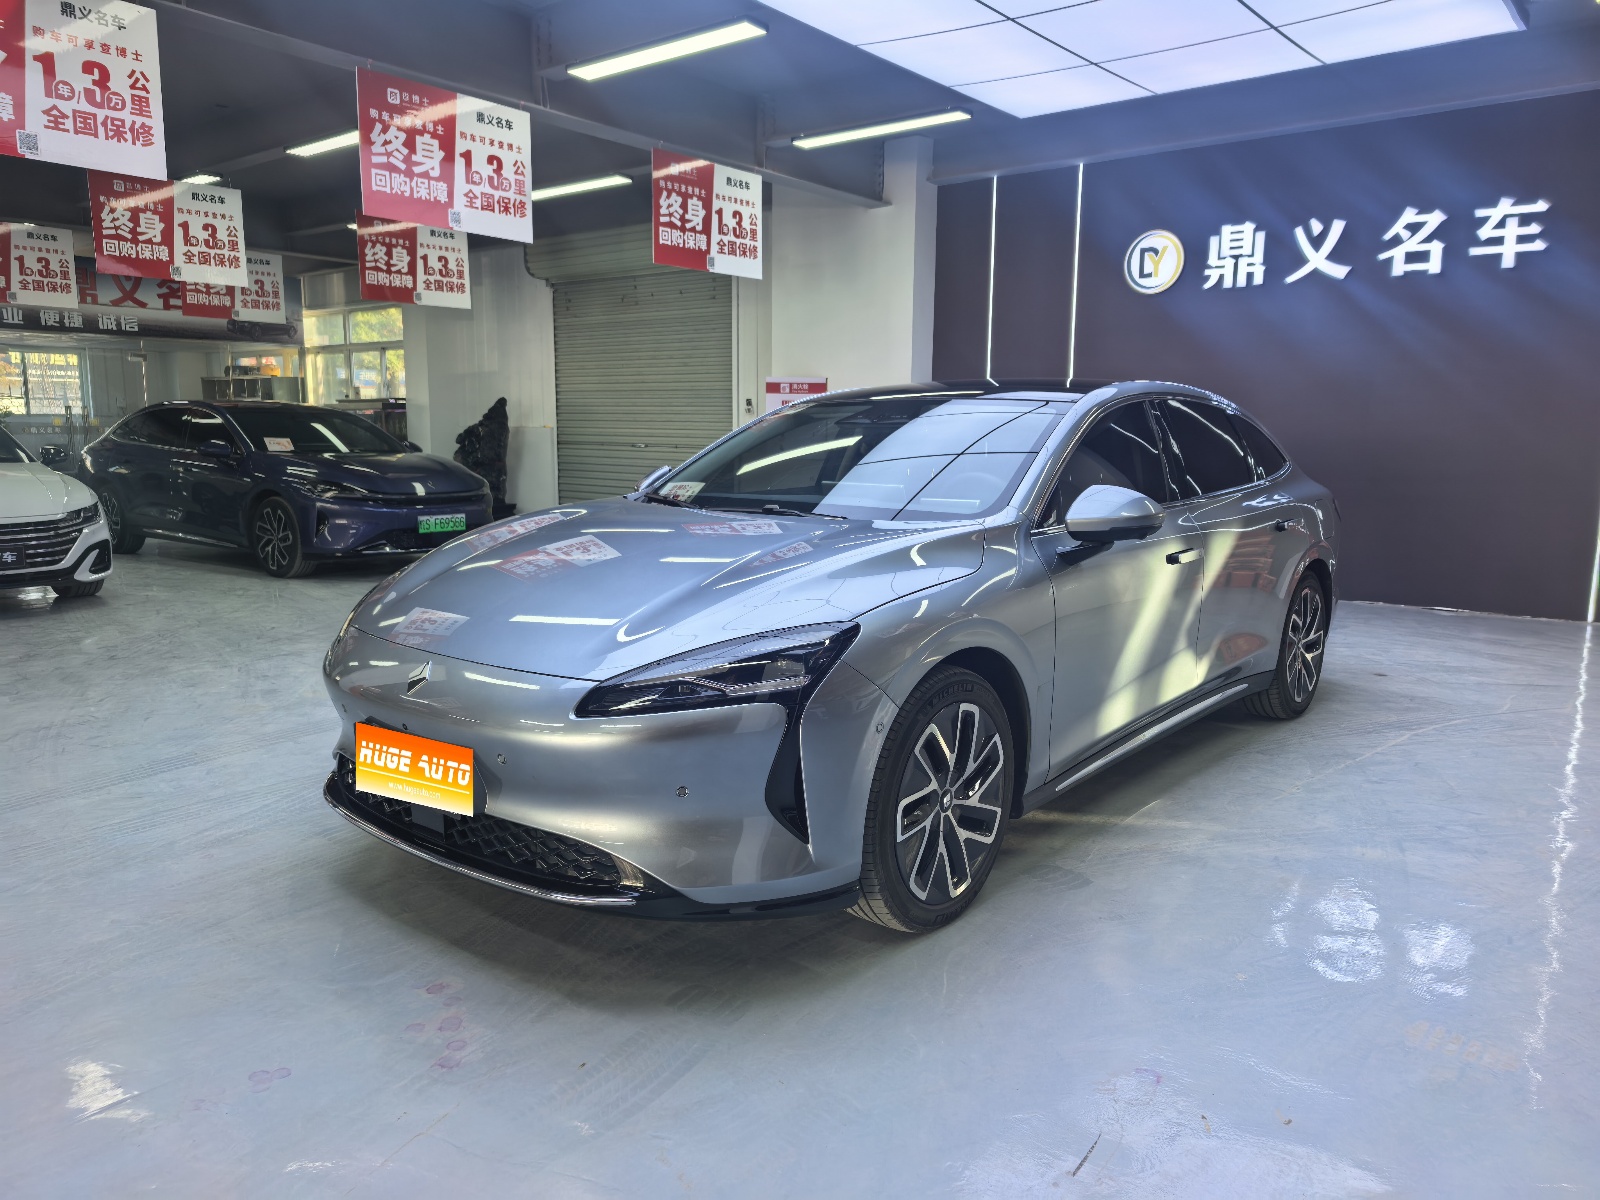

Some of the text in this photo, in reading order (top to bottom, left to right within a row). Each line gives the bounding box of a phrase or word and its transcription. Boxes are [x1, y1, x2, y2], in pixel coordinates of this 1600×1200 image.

[61, 1, 126, 30] 鼎义名车
[32, 25, 143, 62] 购车可享查博士
[41, 104, 155, 147] 全国保修
[369, 107, 445, 135] 购车可查博士
[476, 111, 514, 131] 鼎义名车
[370, 122, 445, 178] 终身
[371, 168, 449, 204] 回购保障
[726, 176, 751, 191] 鼎义名车
[463, 188, 528, 219] 全国保修
[659, 190, 706, 231] 终身
[100, 206, 165, 243] 终身
[103, 239, 170, 262] 回购保障
[659, 226, 707, 252] 回购保障
[716, 238, 758, 260] 全国保修
[1202, 196, 1551, 290] 鼎义名车
[182, 249, 242, 269] 全国保修
[365, 242, 411, 273] 终身
[18, 278, 72, 294] 全国保修
[365, 270, 414, 289] 回购保障
[423, 278, 467, 294] 全国保修
[186, 292, 231, 307] 回购保障
[240, 298, 281, 311] 全国保修
[40, 309, 84, 328] 便捷
[98, 313, 139, 332] 诚信
